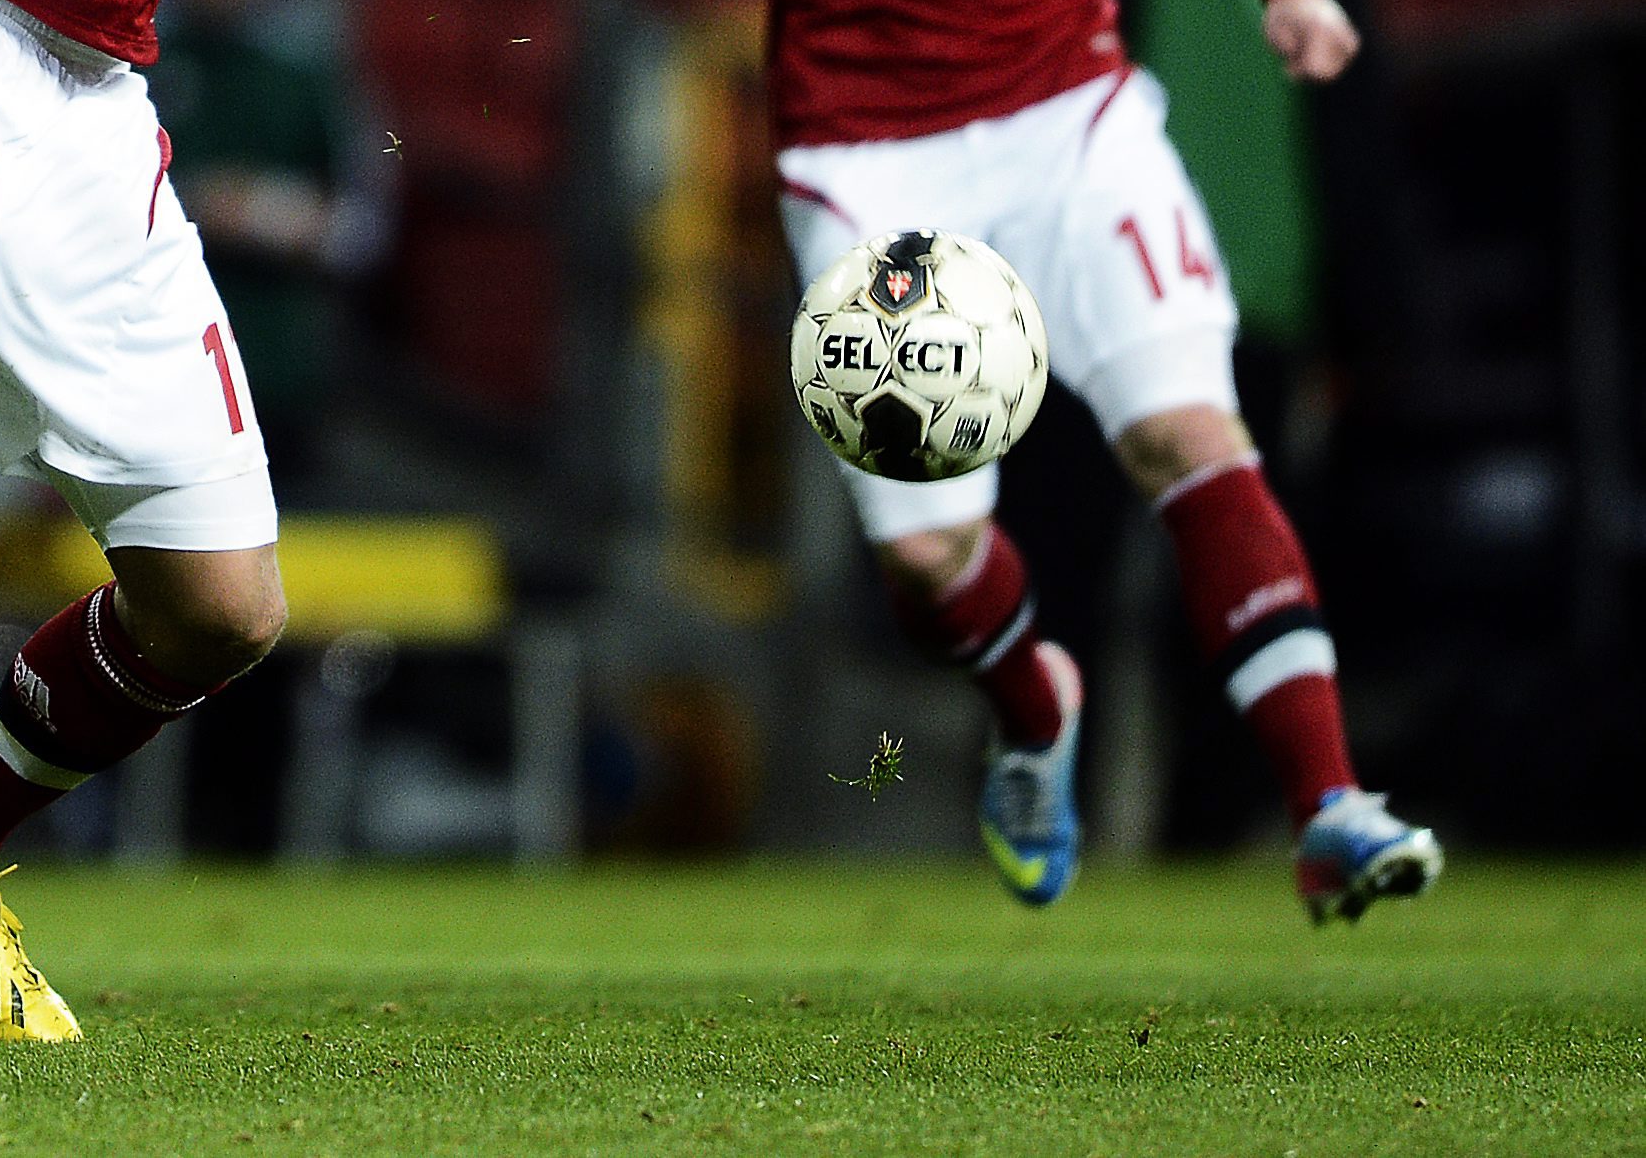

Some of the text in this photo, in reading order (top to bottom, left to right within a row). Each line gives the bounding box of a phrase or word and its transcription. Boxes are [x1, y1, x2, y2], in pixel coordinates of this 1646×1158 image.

[1114, 205, 1216, 300] 14
[202, 322, 244, 435] 1
[822, 334, 967, 373] SELECT
